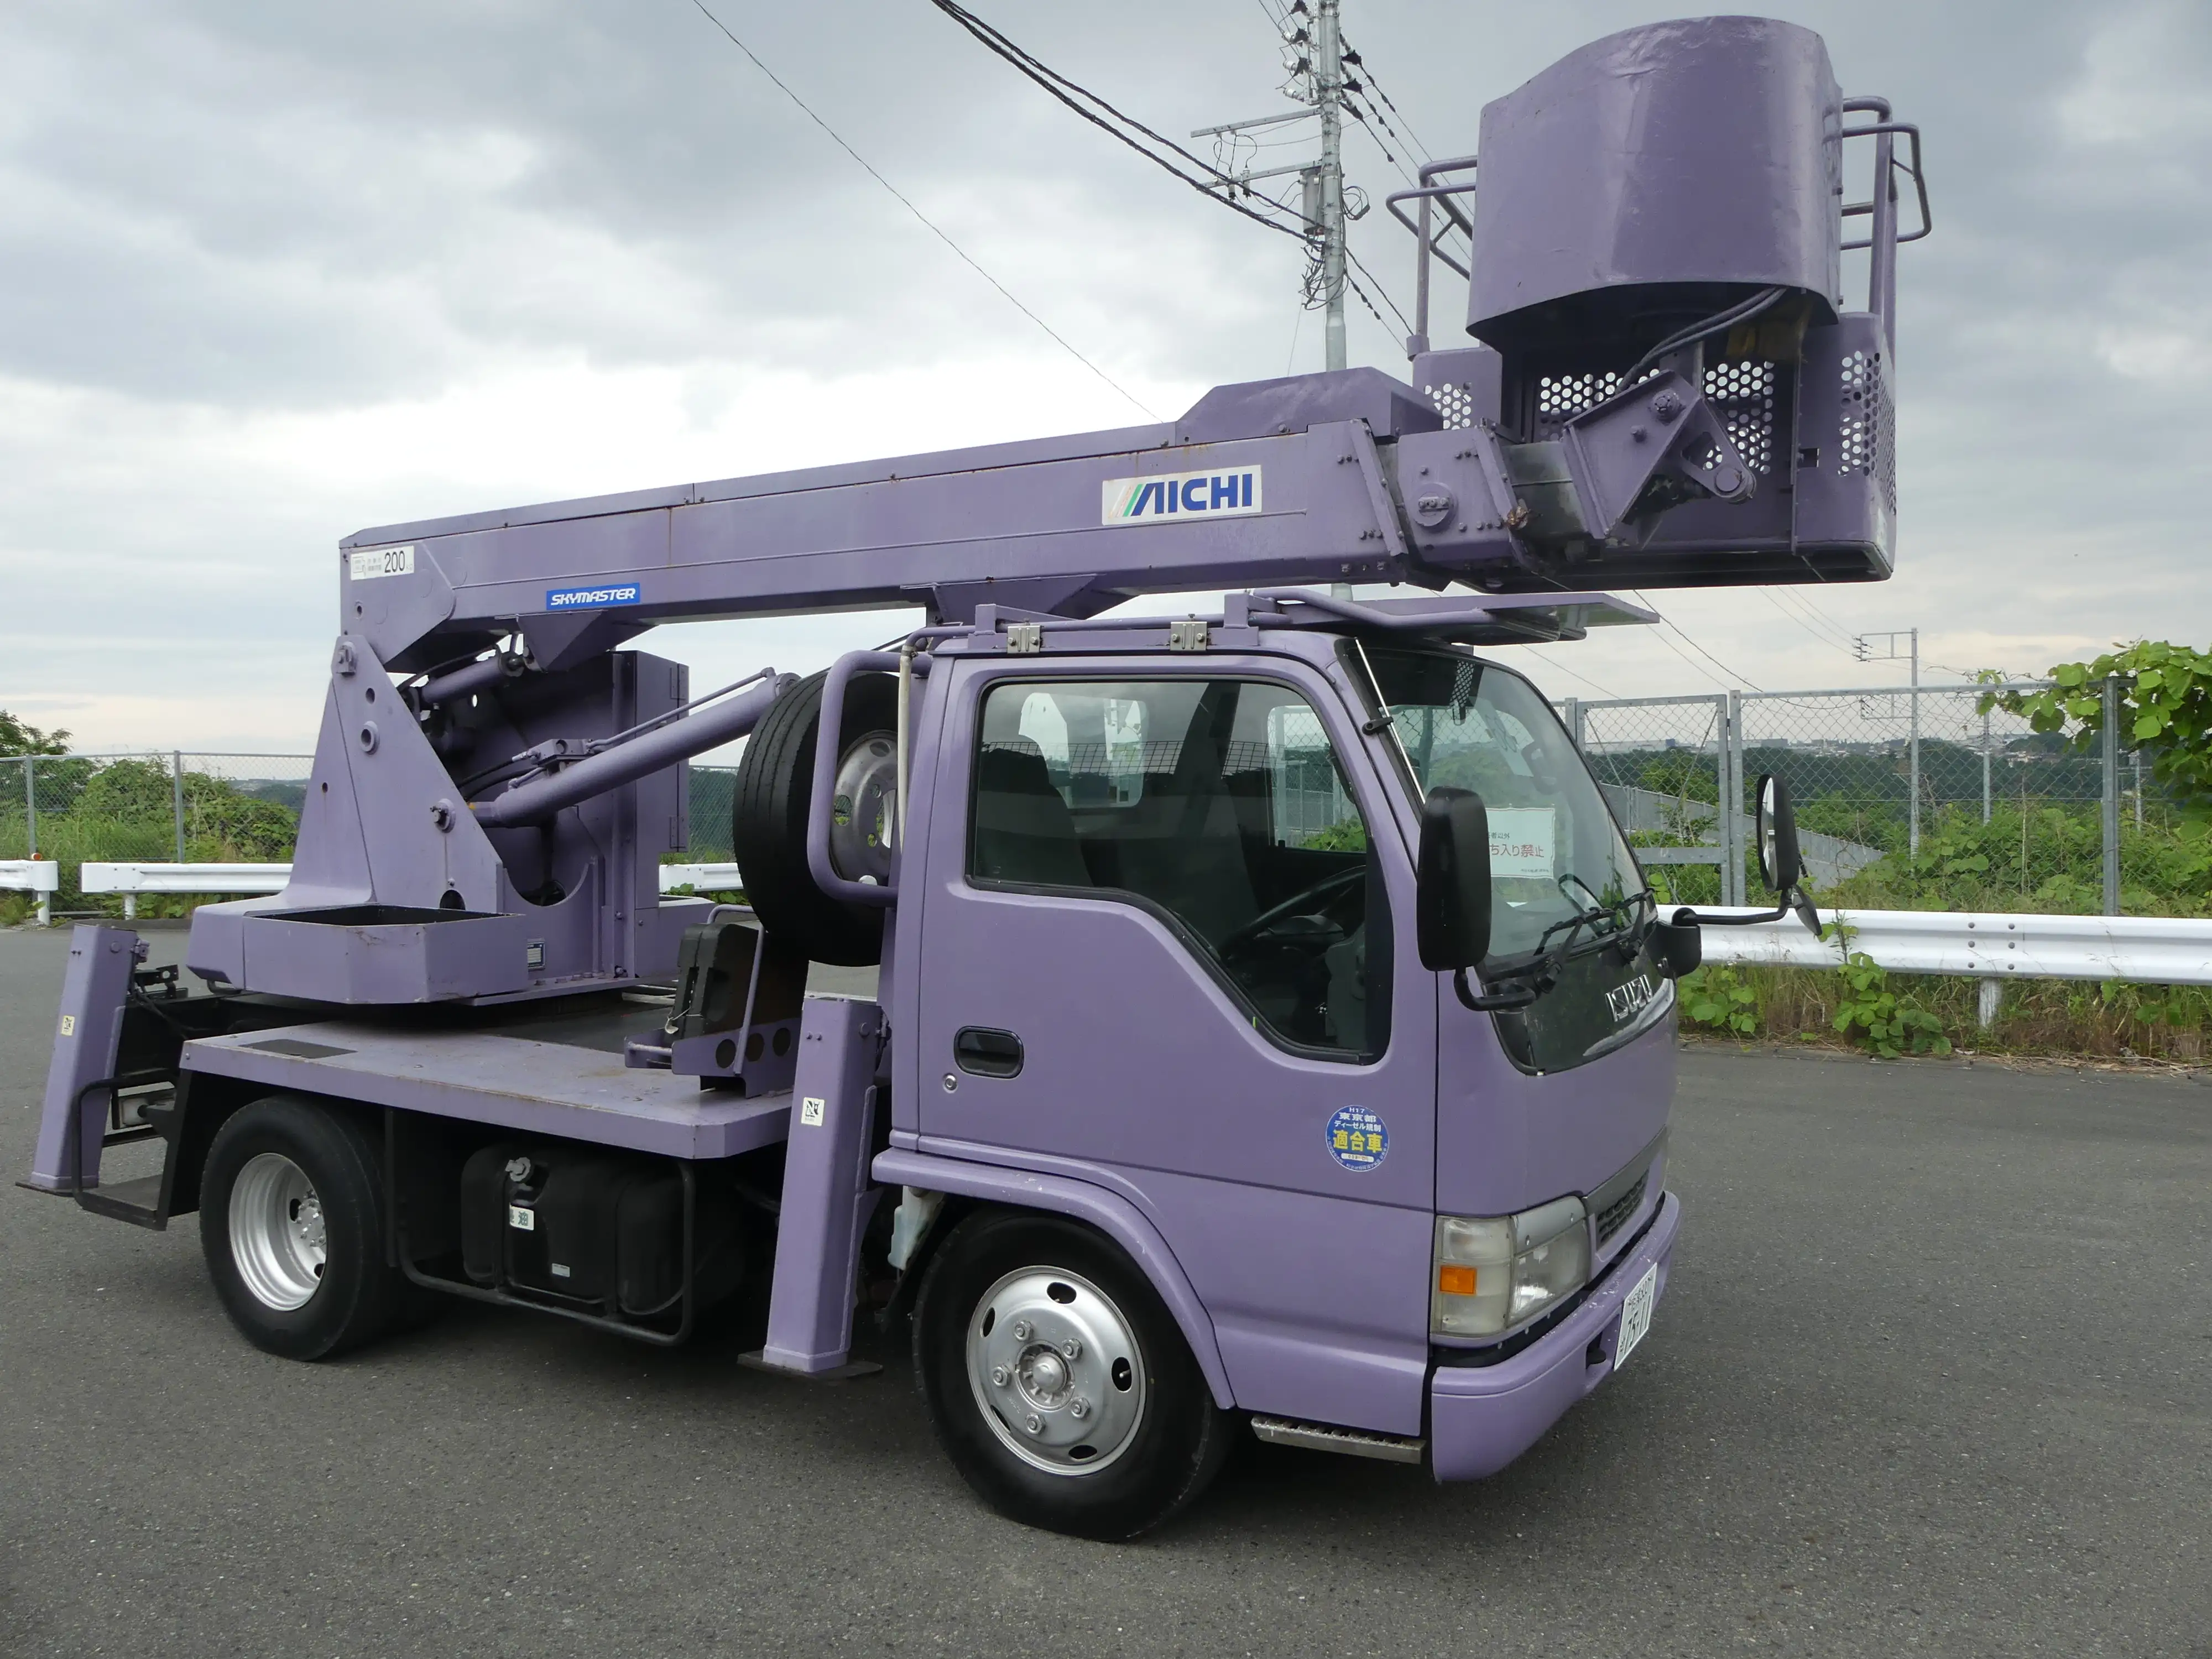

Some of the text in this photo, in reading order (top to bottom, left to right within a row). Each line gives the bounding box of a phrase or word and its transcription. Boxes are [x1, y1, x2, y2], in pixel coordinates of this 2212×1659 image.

[1131, 473, 1253, 517] AICHI
[384, 550, 405, 573] 200
[551, 588, 636, 606] SKYMASTER
[1605, 974, 1653, 1022] ISUZU
[1334, 1120, 1381, 1132] ディーゼル規制
[1339, 1112, 1376, 1123] 東京都
[1333, 1129, 1383, 1153] 適合車
